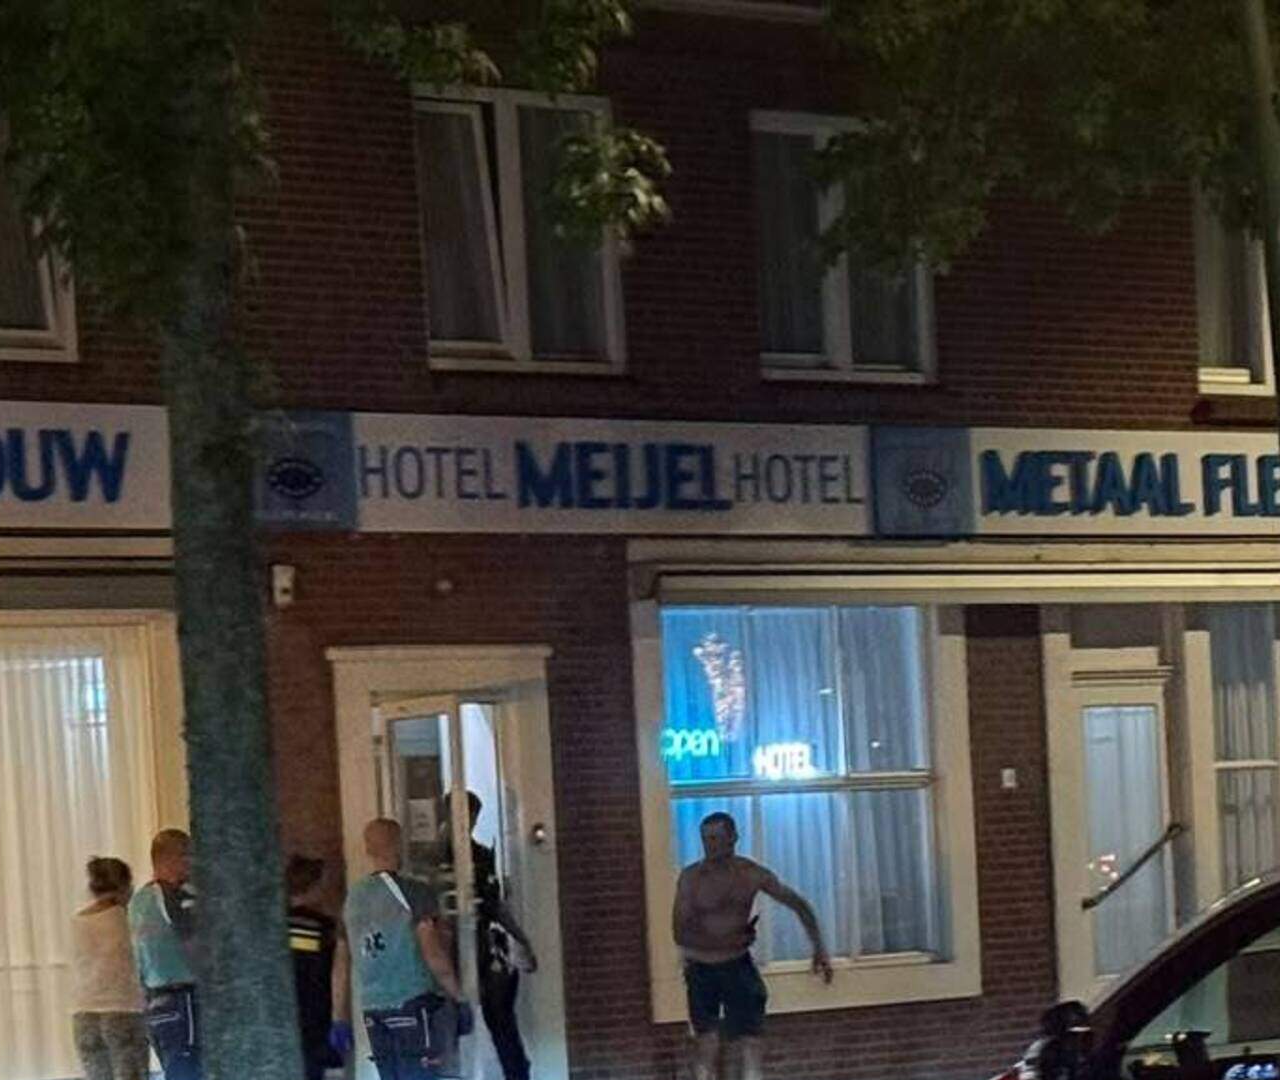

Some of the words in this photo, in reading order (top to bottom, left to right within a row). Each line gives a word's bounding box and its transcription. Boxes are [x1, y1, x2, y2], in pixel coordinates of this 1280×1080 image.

[356, 445, 506, 501] HOTEL
[733, 453, 866, 504] HOTEL
[980, 450, 1197, 517] METAAL
[661, 728, 720, 761] open
[754, 742, 816, 780] HOTEL
